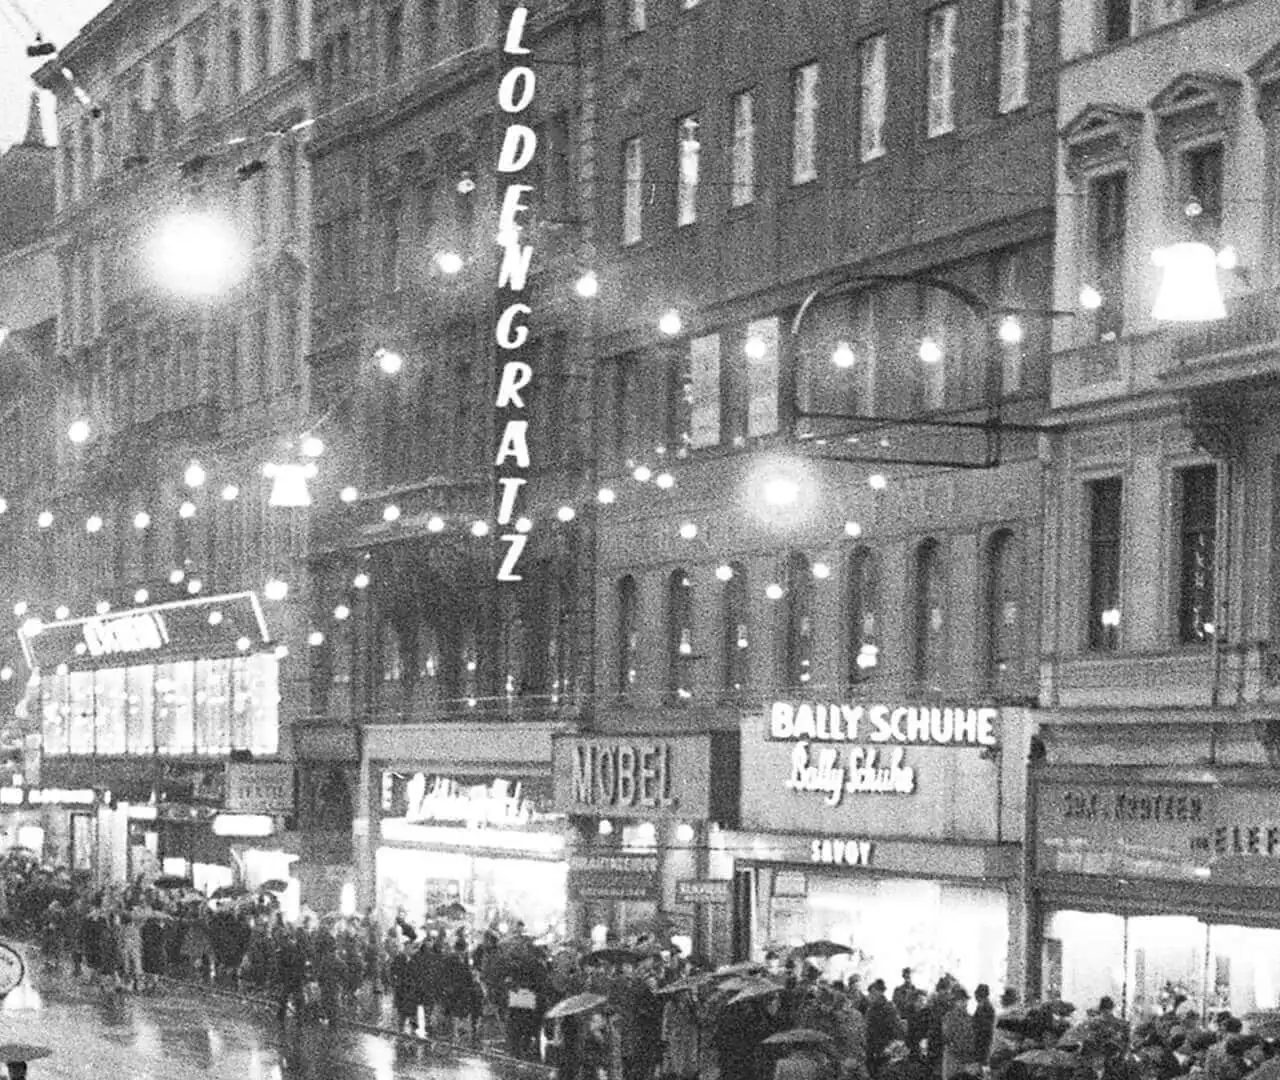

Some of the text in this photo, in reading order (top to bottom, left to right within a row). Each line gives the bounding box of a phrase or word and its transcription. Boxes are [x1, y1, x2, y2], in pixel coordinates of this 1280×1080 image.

[771, 701, 998, 745] BALLY SCHUHE
[786, 741, 916, 806] Bally Schuhe
[811, 839, 871, 866] SAVOY
